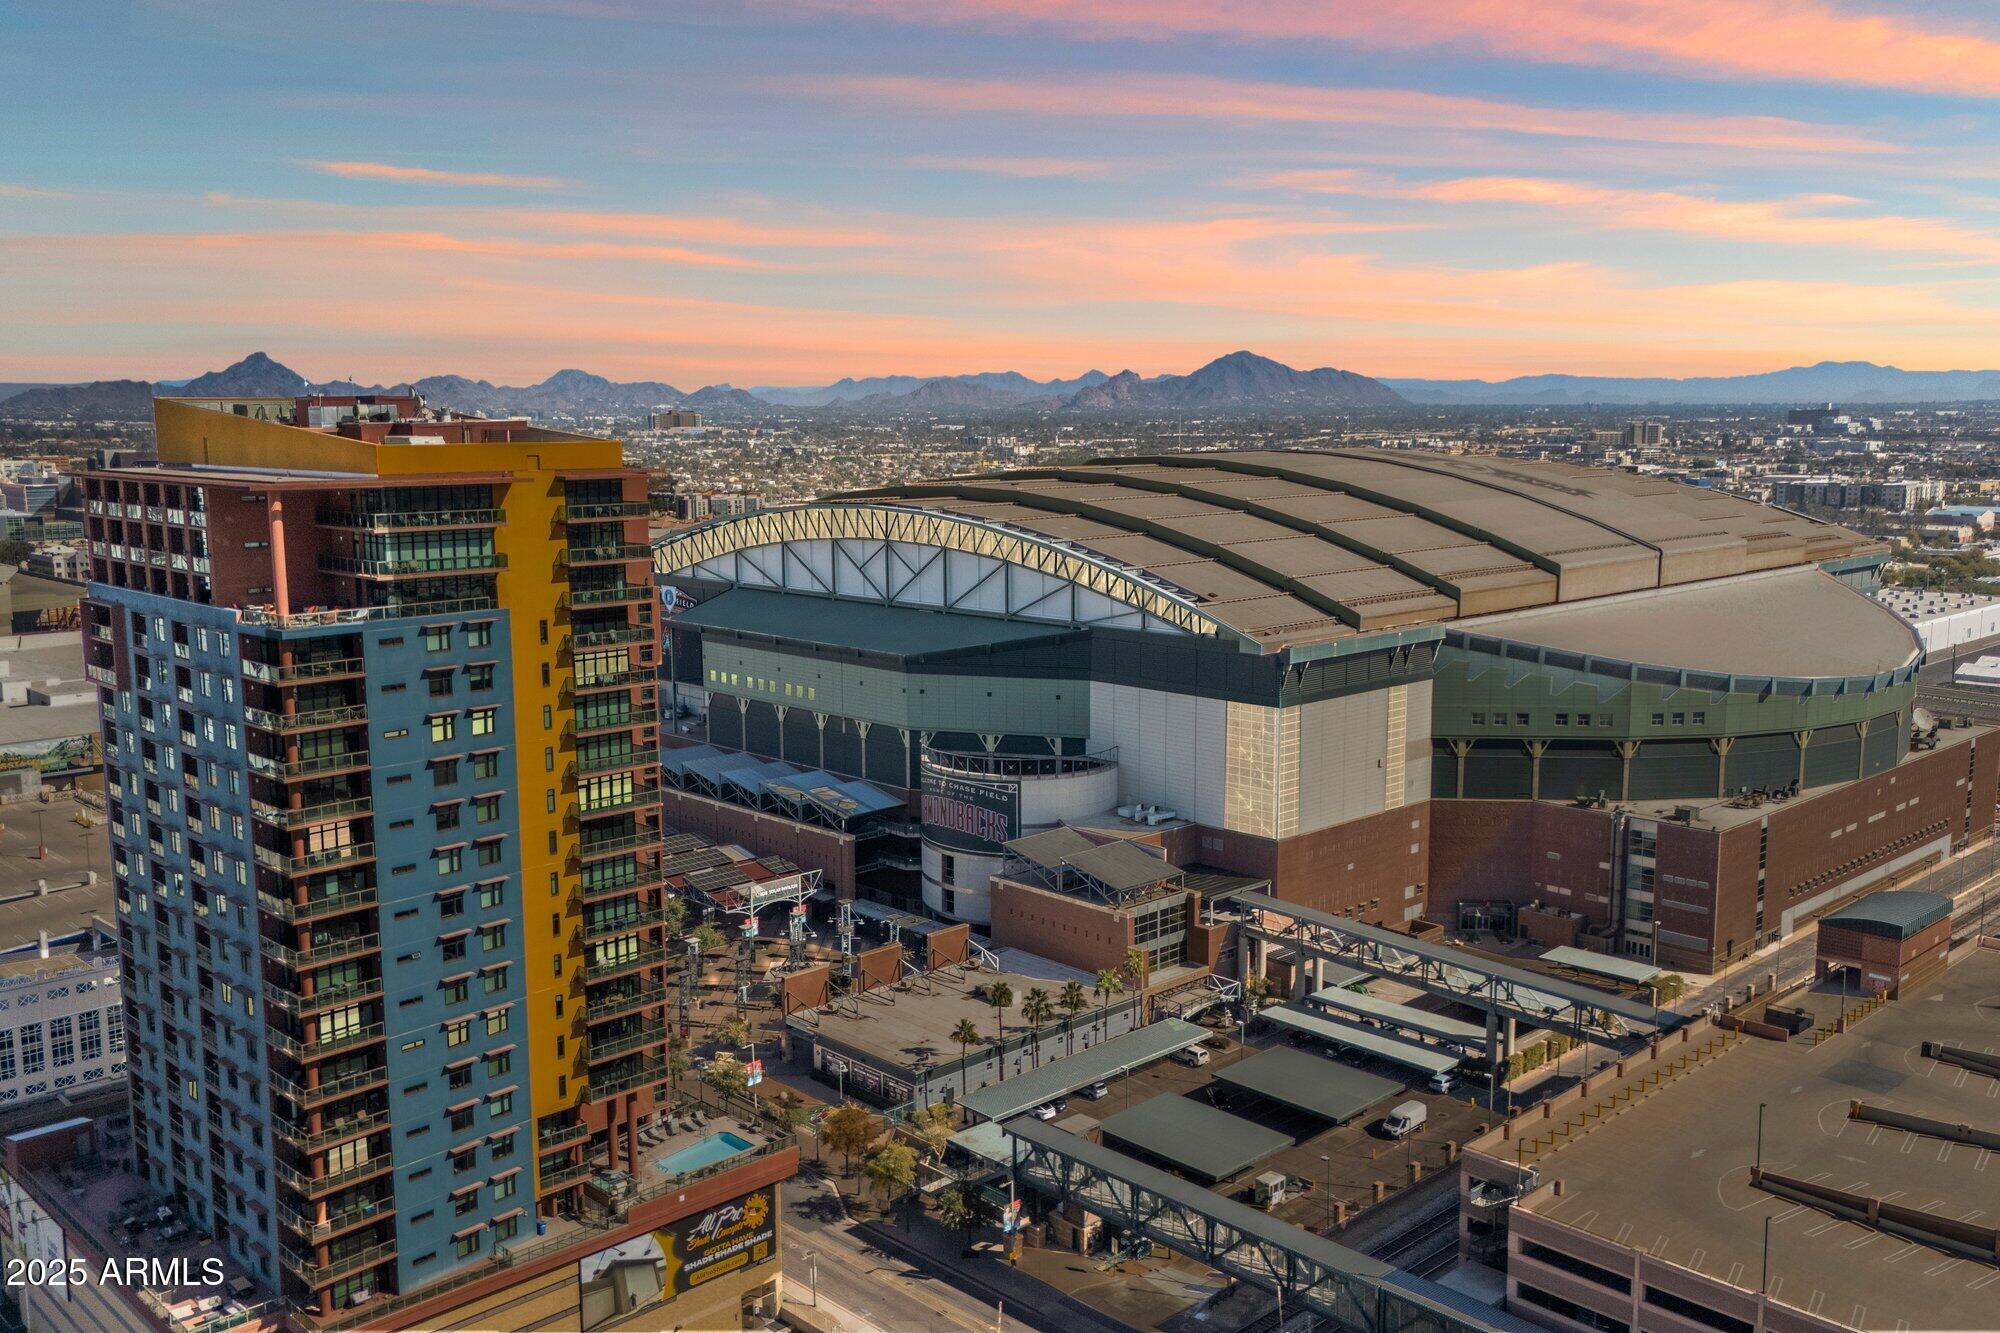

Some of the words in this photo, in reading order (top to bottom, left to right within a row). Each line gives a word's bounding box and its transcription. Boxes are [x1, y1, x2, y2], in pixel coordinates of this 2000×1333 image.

[949, 783, 976, 793] CHASE
[979, 790, 1008, 801] FIELD
[684, 1254, 714, 1271] SHADE
[714, 1243, 744, 1258] SHADE
[745, 1230, 772, 1246] SHADE
[704, 1241, 731, 1255] GOTTA
[731, 1232, 754, 1245] HAVE
